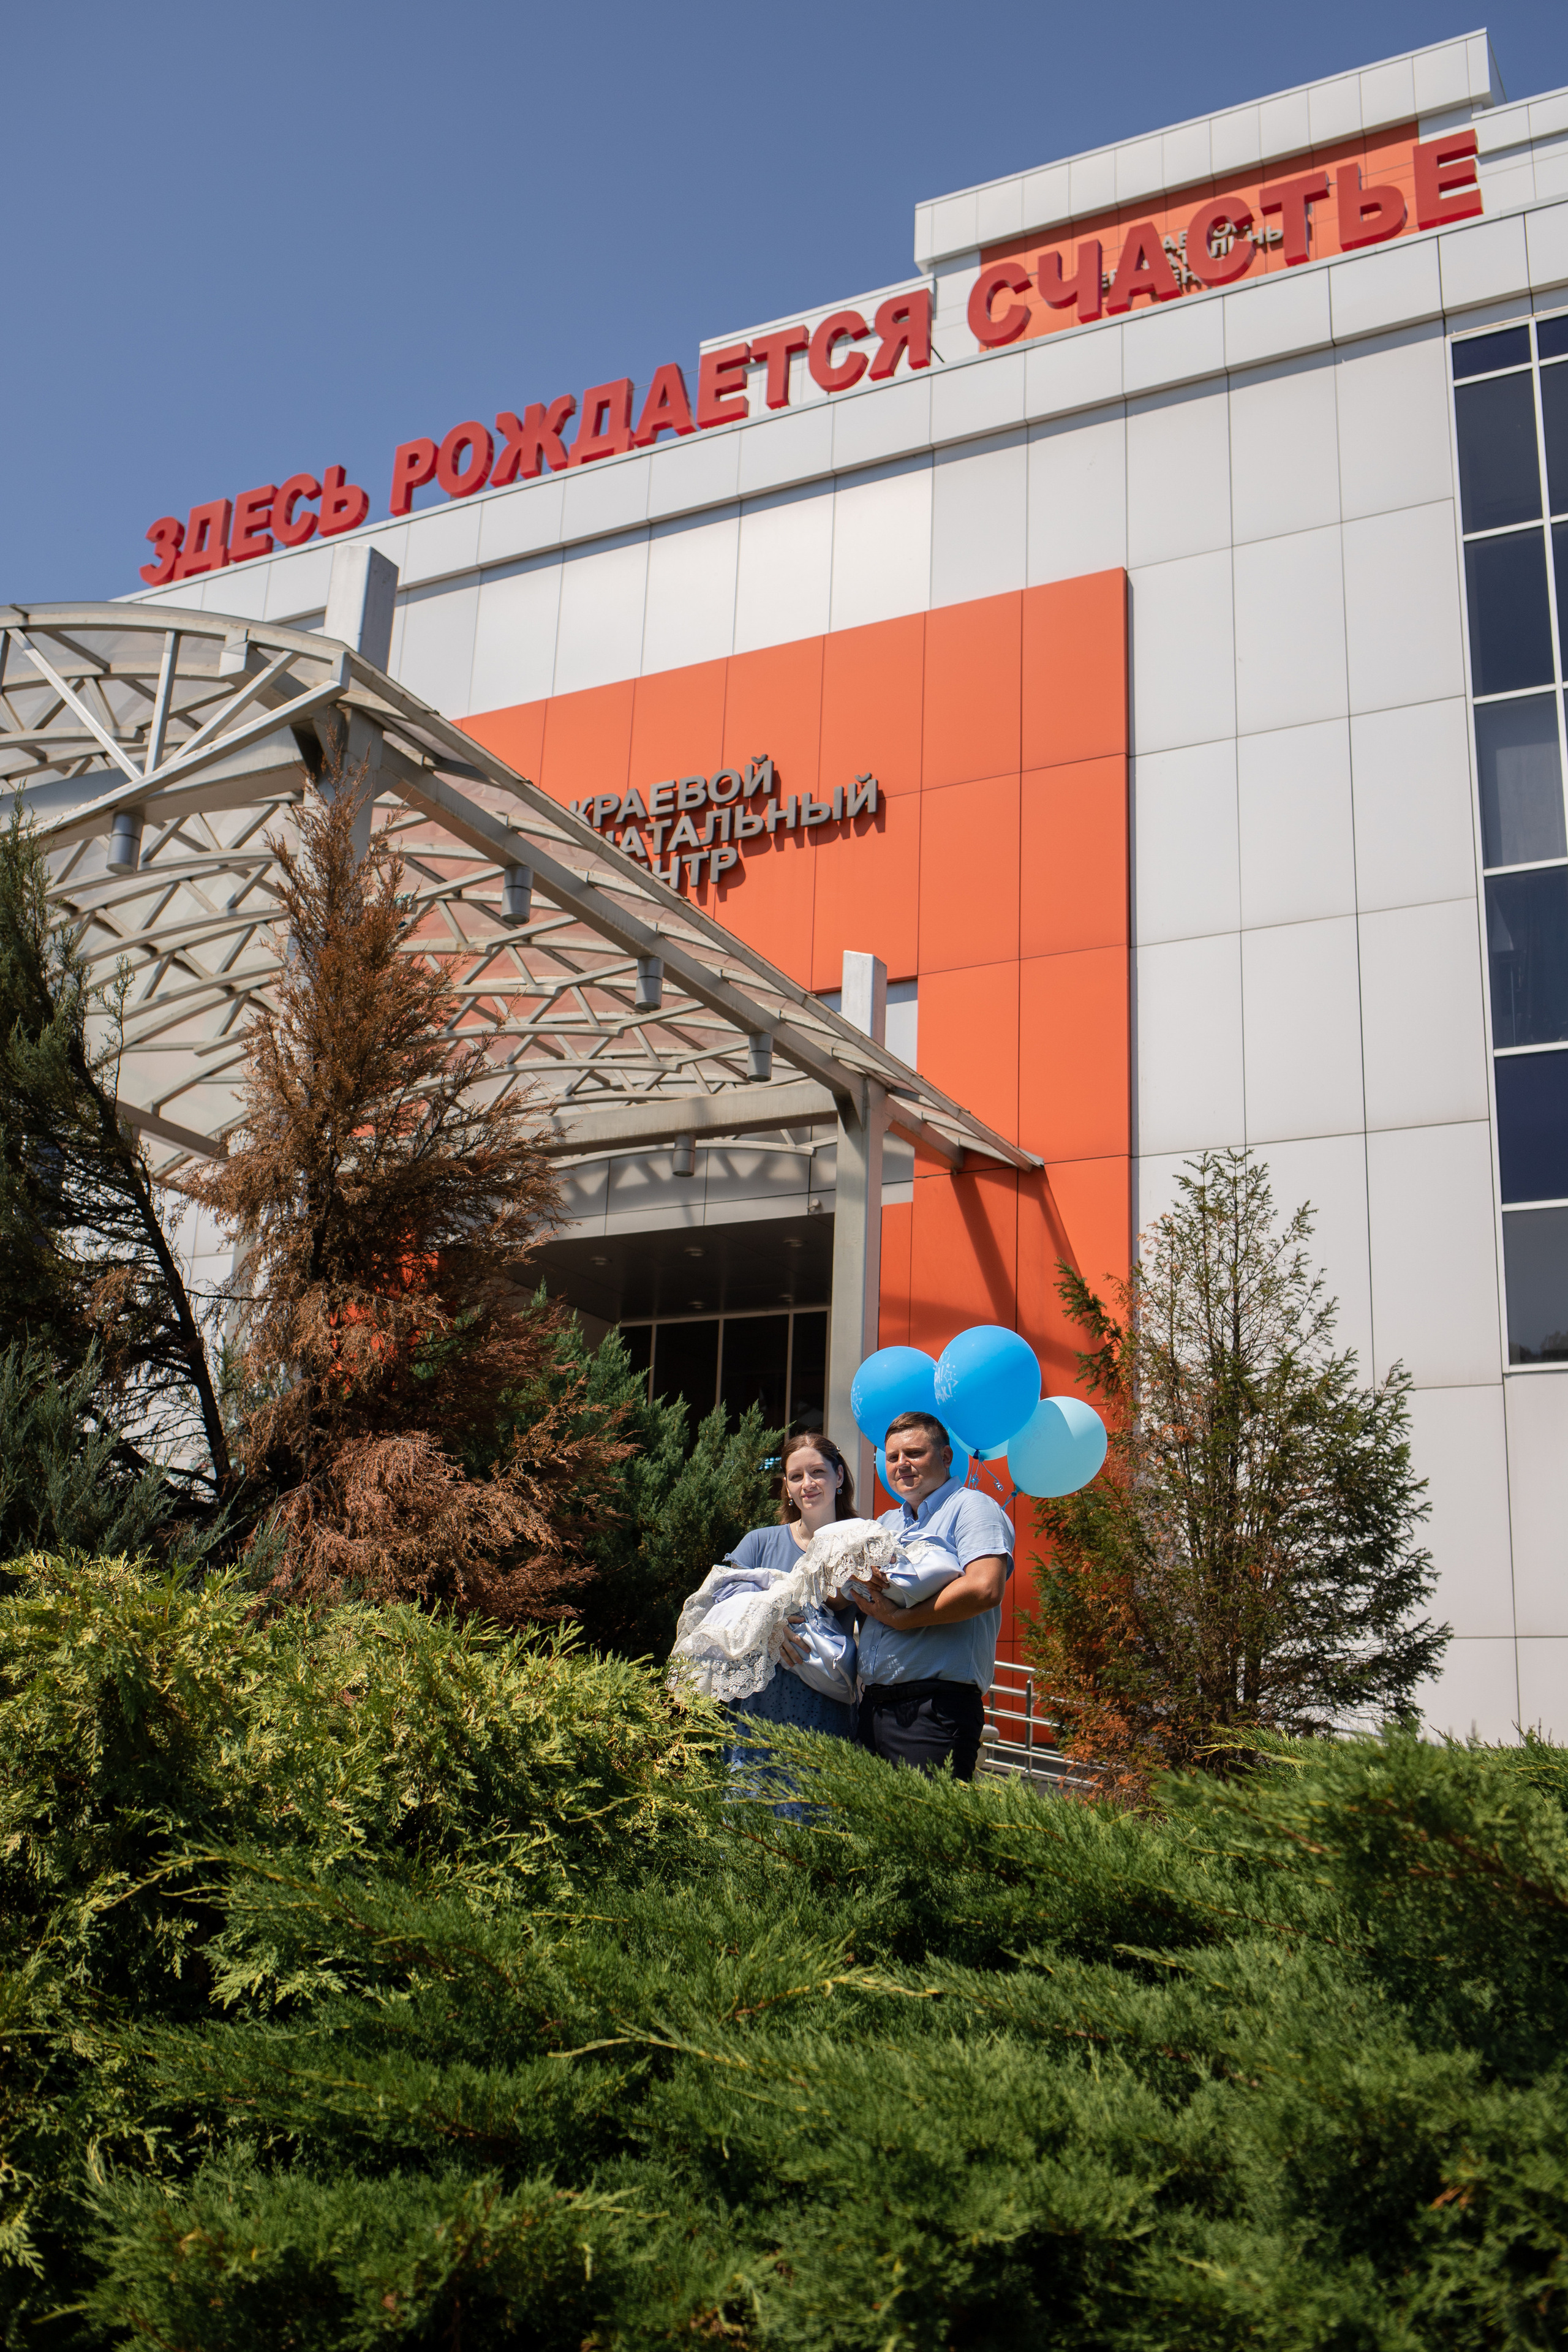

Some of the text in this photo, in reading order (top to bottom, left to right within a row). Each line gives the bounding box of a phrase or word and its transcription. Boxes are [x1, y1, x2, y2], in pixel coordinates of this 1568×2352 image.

[139, 129, 1484, 586] ЗДЕСЬ РОЖДАЕТСЯ СЧАСТЬЕ
[605, 772, 878, 858] АТАЛЬНЫЙ
[640, 846, 738, 890] НТР
